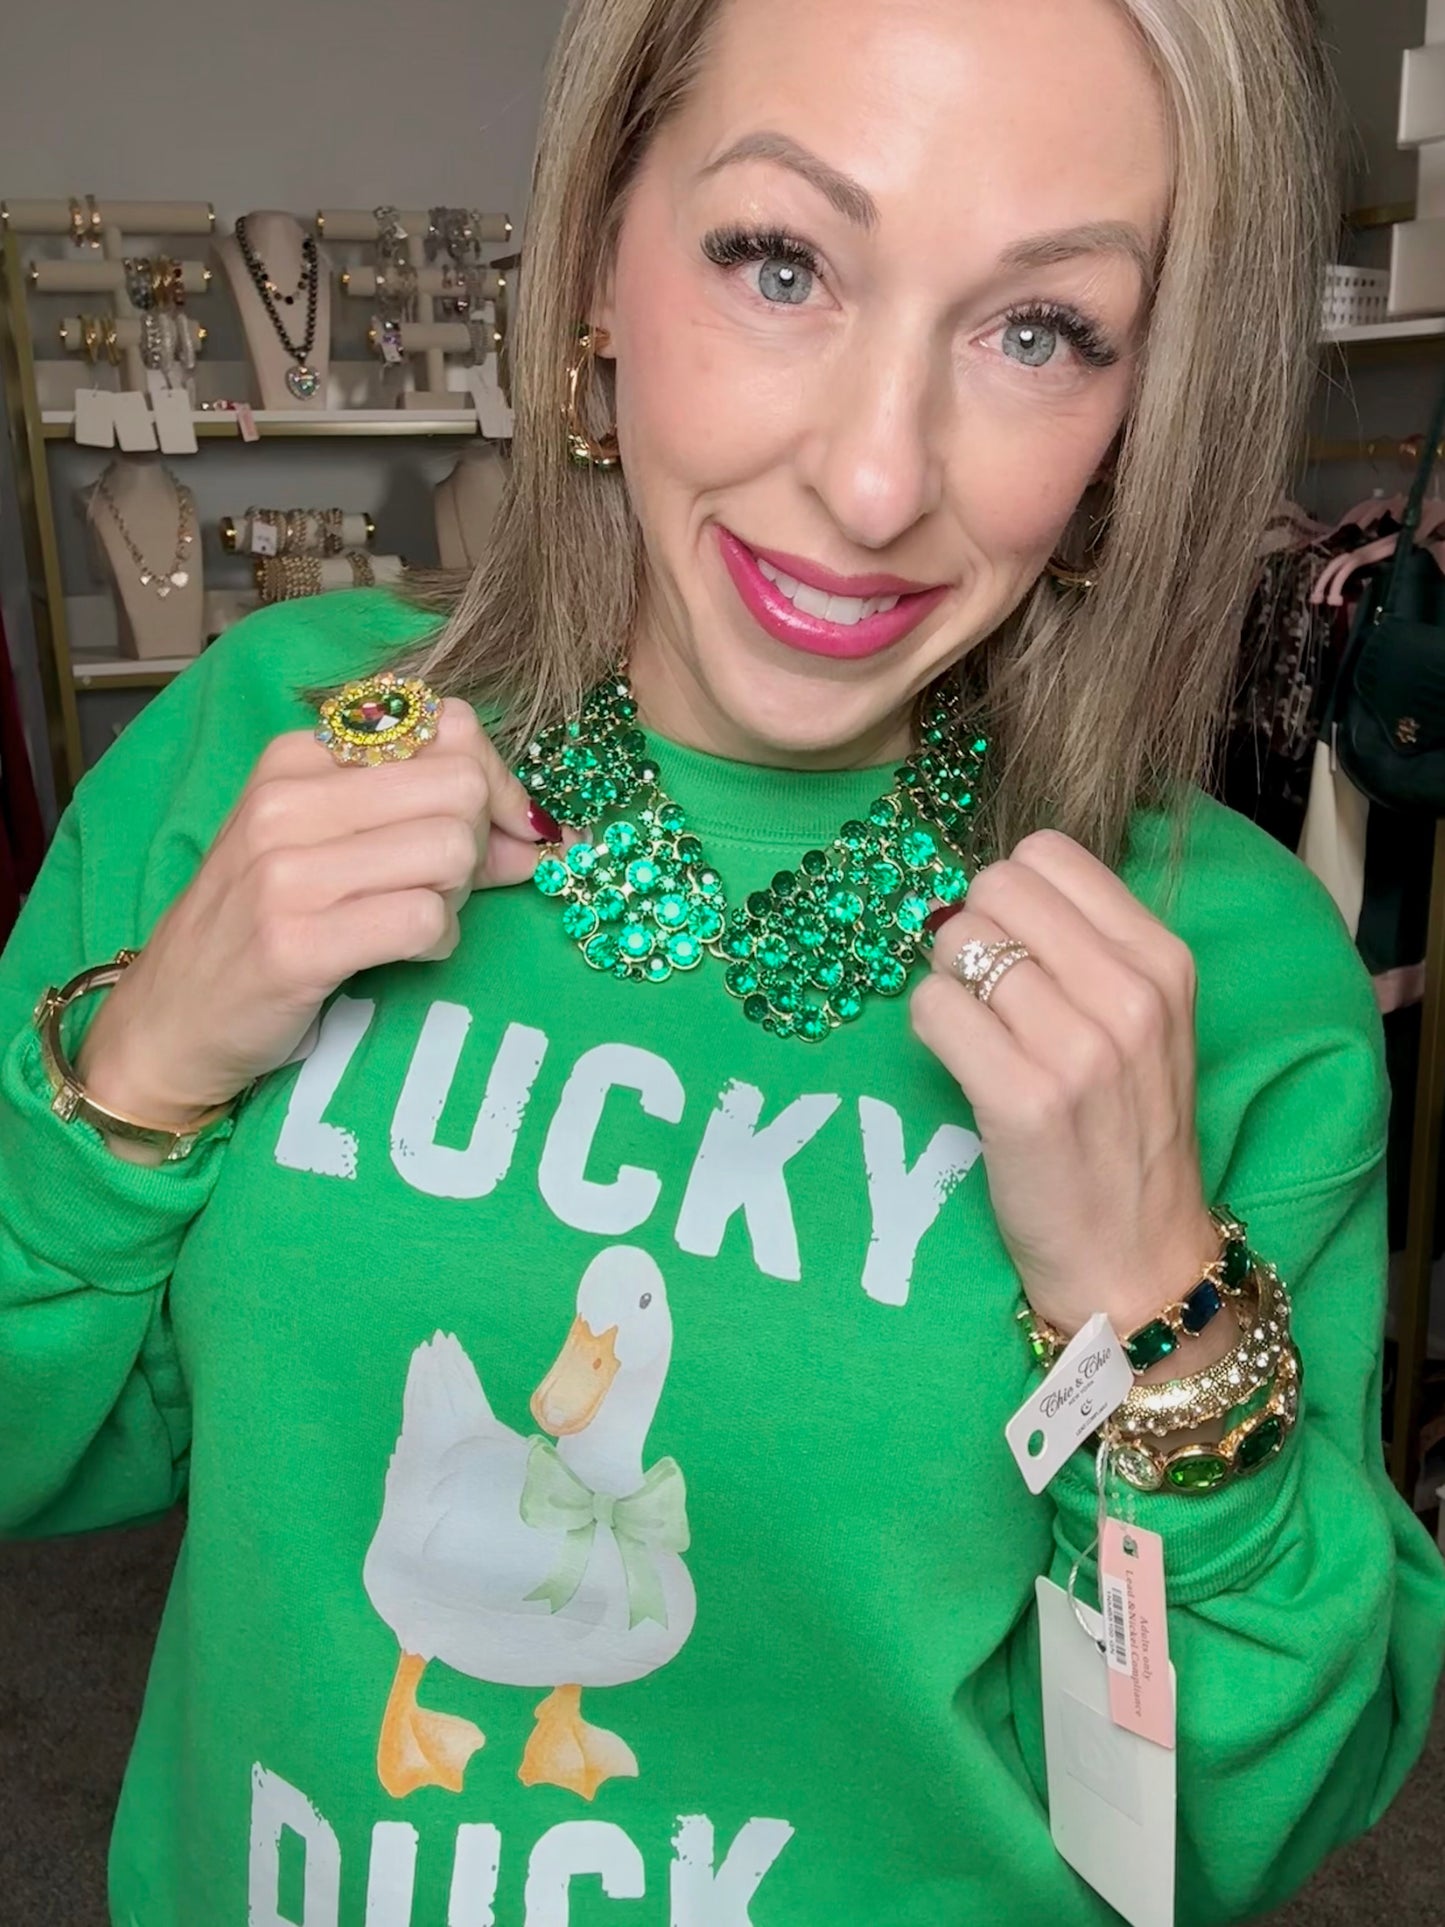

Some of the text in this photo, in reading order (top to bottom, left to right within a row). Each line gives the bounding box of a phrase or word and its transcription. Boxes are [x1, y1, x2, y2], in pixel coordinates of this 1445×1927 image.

[273, 995, 984, 1306] LUCKY
[1075, 1378, 1084, 1388] &
[1125, 1569, 1136, 1599] Lead
[1140, 1615, 1153, 1682] Adults only
[1130, 1651, 1142, 1718] Compliance
[248, 1761, 796, 1927] DUCK
